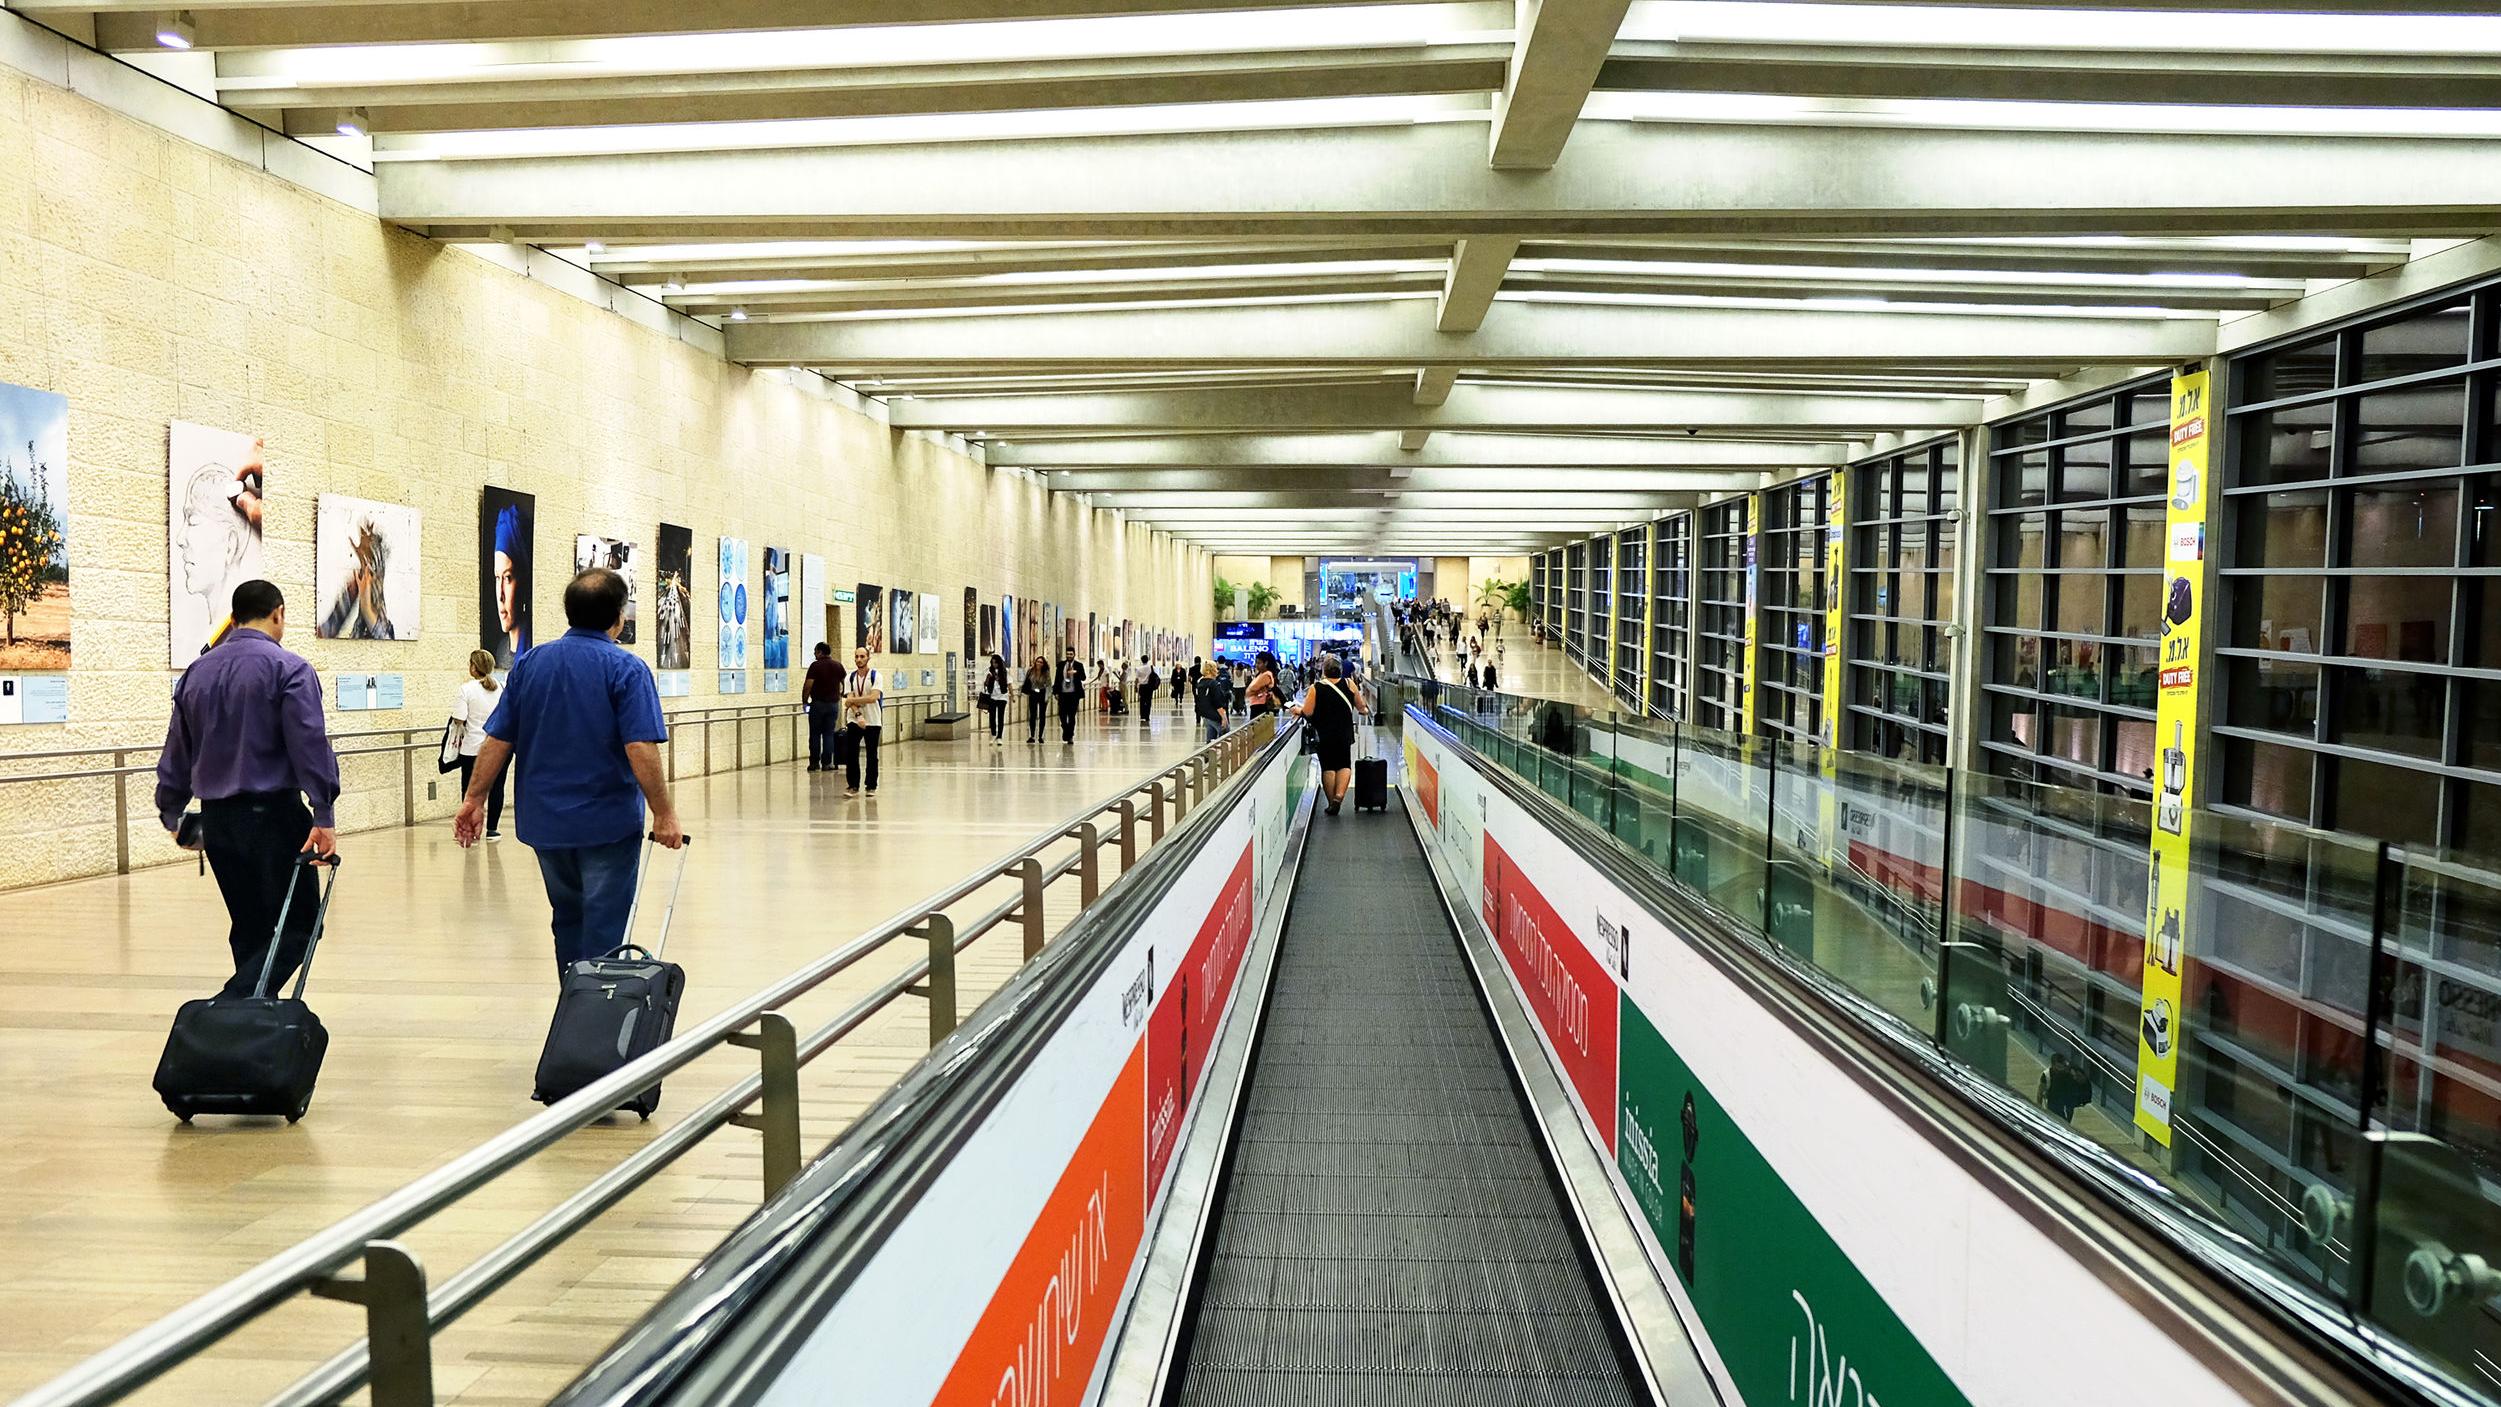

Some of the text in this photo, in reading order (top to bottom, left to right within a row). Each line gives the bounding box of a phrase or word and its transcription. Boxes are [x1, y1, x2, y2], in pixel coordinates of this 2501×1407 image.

[2173, 419, 2203, 443] DUTY FREE
[2180, 537, 2196, 547] BOSCH
[1229, 644, 1269, 652] BALENO
[2162, 670, 2191, 686] DUTY FREE
[1596, 904, 1619, 952] NESPRESSO
[2151, 1092, 2167, 1110] BOSCH
[1624, 1090, 1664, 1196] inissia
[1088, 1169, 1108, 1296] אז
